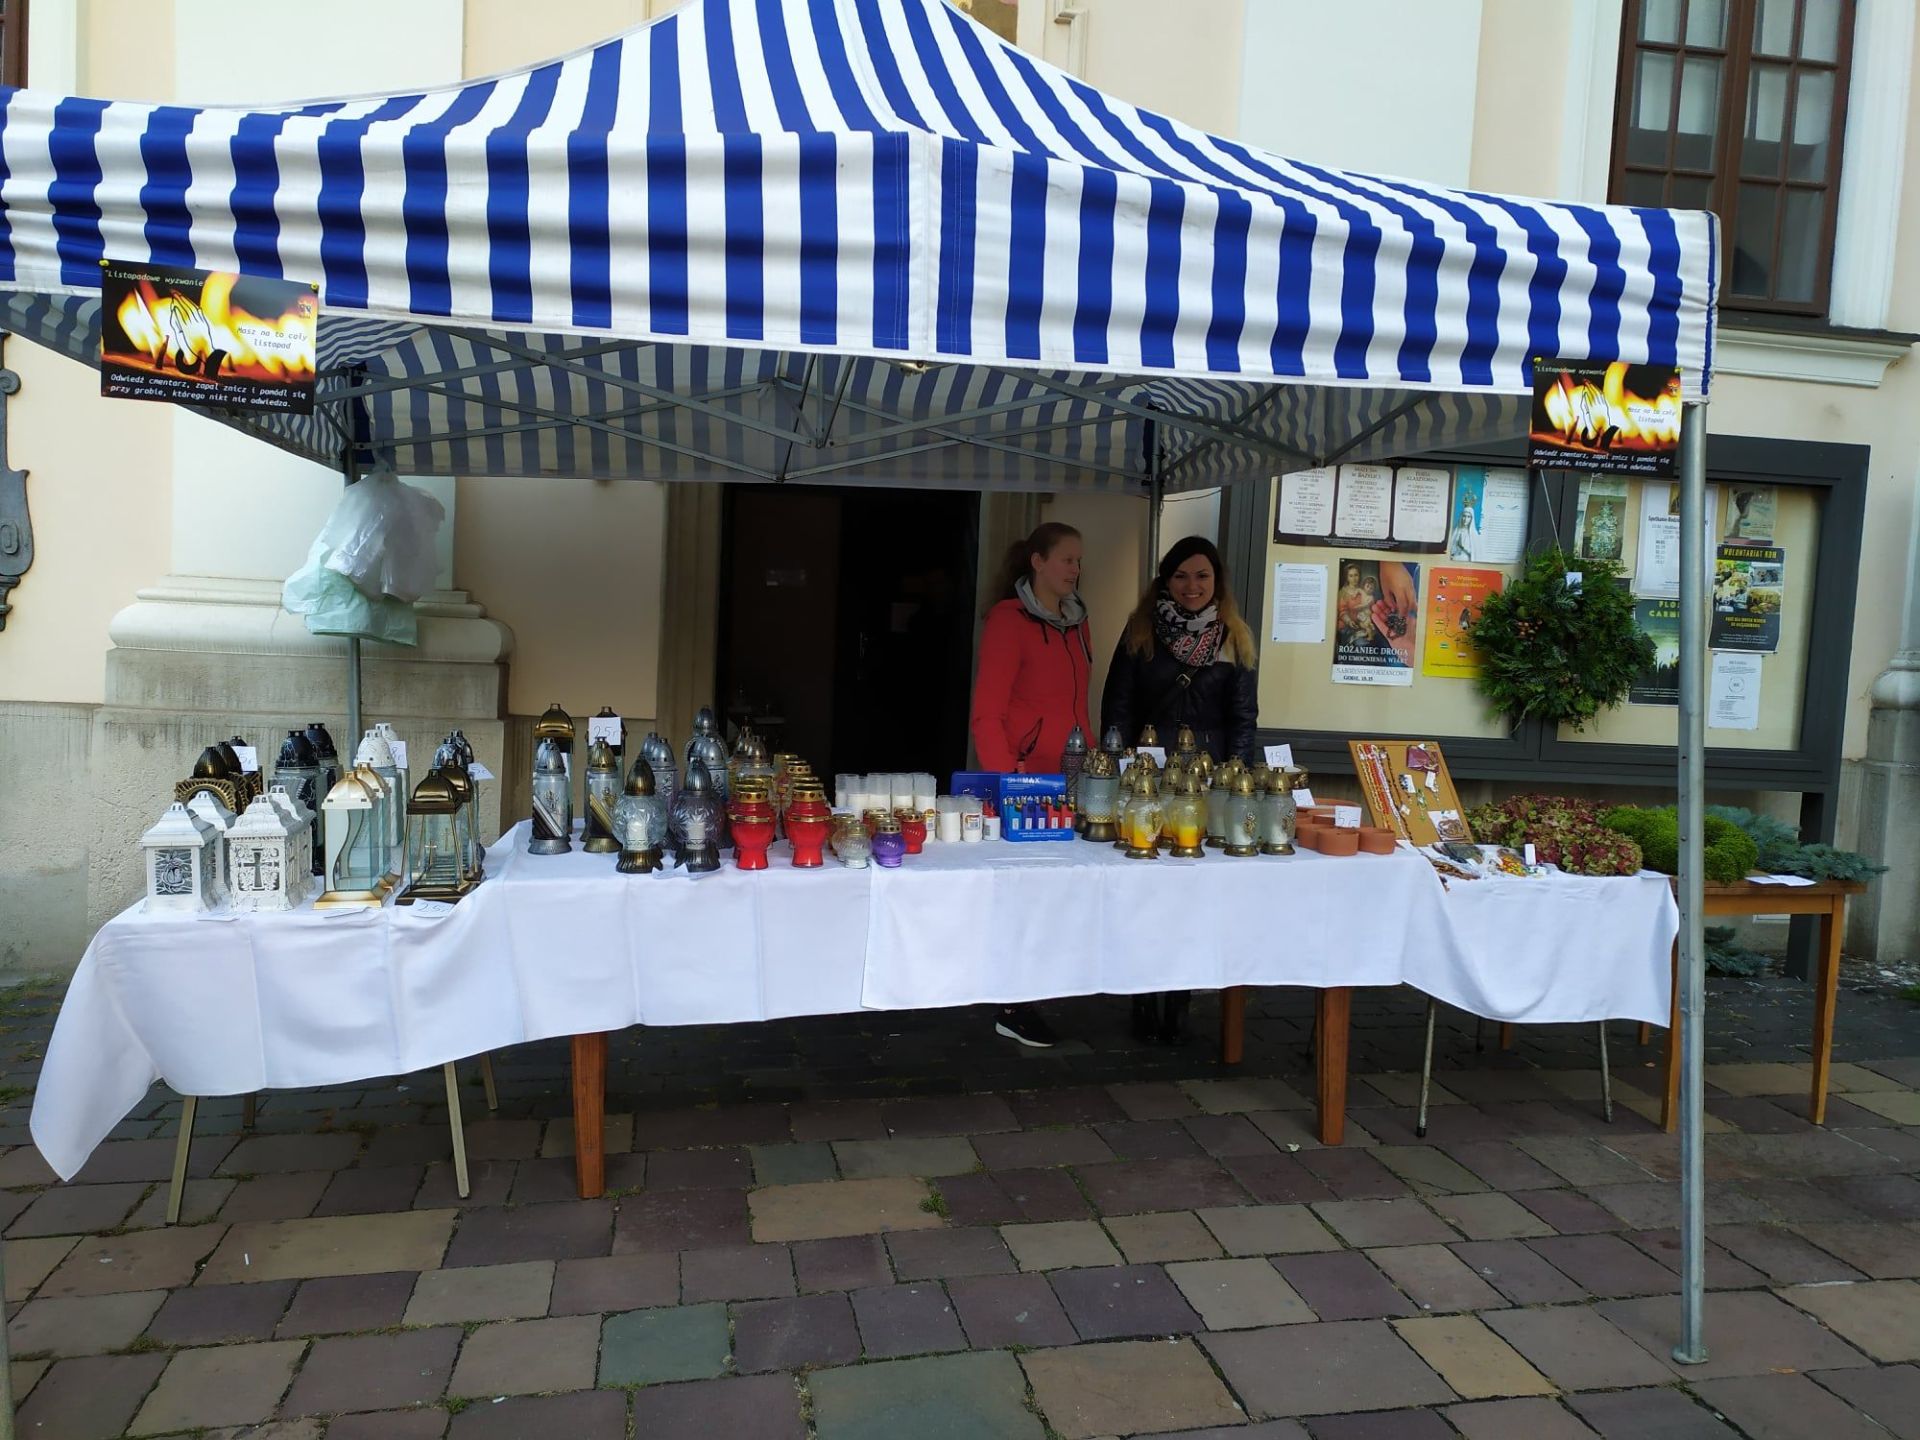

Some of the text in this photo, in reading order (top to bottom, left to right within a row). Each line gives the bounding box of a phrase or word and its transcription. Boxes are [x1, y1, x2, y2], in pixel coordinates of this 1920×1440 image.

[254, 338, 292, 349] listopad
[110, 384, 131, 394] przy
[172, 389, 205, 399] którego
[209, 393, 228, 401] nikt
[149, 377, 190, 389] cmentarz,
[223, 385, 247, 393] znicz
[292, 391, 307, 400] się
